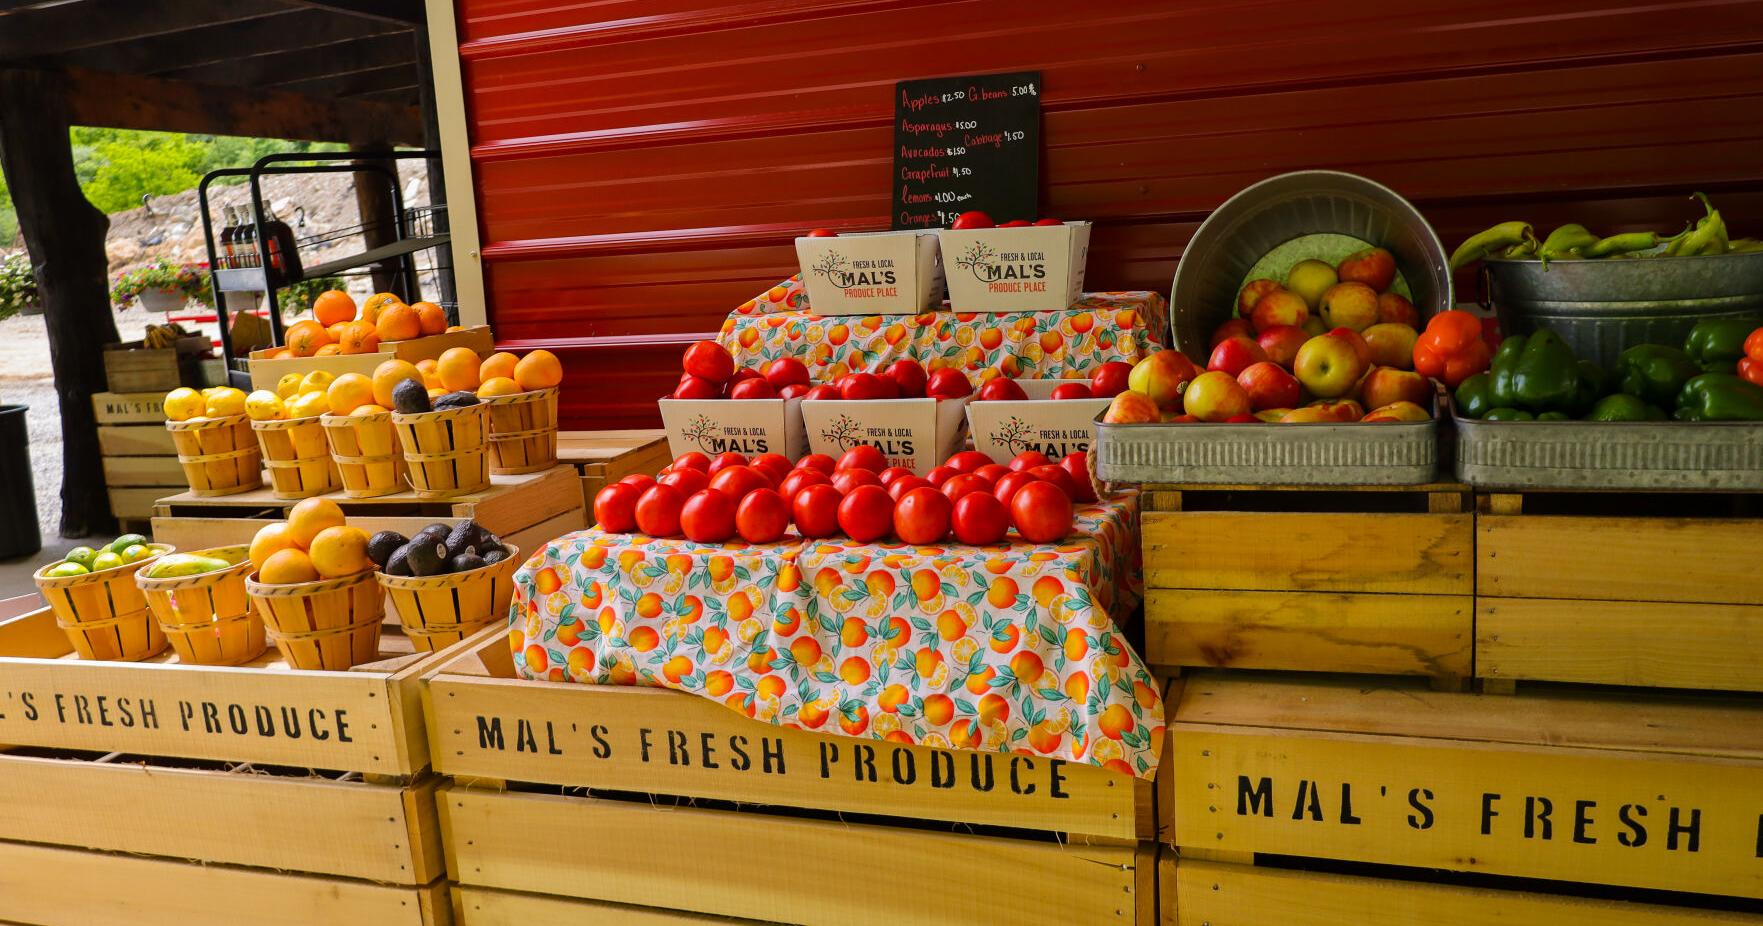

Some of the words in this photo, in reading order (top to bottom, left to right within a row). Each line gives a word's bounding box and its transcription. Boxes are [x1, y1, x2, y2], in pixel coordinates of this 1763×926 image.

[902, 88, 940, 112] Apples
[942, 91, 965, 103] $2.50
[981, 87, 1008, 100] beans
[902, 119, 953, 138] Asparagus
[964, 133, 1002, 149] Cabbage
[901, 145, 945, 159] Avocados
[956, 193, 972, 202] each
[900, 212, 938, 227] Oranges
[1000, 252, 1019, 262] FRESH
[1020, 252, 1026, 261] &
[1027, 251, 1045, 261] LOCAL
[852, 261, 870, 270] FRESH
[871, 261, 876, 269] &
[877, 259, 895, 269] LOCAL
[841, 271, 896, 286] MAL'S
[986, 264, 1046, 280] MAL'S
[844, 288, 874, 299] PRODUCE
[876, 287, 898, 298] PLACE
[988, 282, 1022, 293] PRODUCE
[1023, 281, 1047, 292] PLACE
[723, 427, 741, 436] FRESH
[742, 427, 748, 436] &
[749, 427, 766, 436] LOCAL
[867, 428, 886, 437] FRESH
[887, 428, 893, 437] &
[894, 428, 913, 438] LOCAL
[1040, 430, 1060, 440] FRESH
[1061, 430, 1068, 439] &
[1069, 430, 1090, 439] LOCAL
[712, 438, 769, 453] MAL'S
[893, 458, 916, 469] PLACE
[54, 693, 159, 729] FRESH
[179, 700, 353, 743] PRODUCE
[476, 715, 612, 759] MAL'S
[640, 728, 787, 774] FRESH
[819, 741, 1071, 798] PRODUCE
[1237, 775, 1434, 830] MAL'S
[1480, 793, 1701, 852] FRESH
